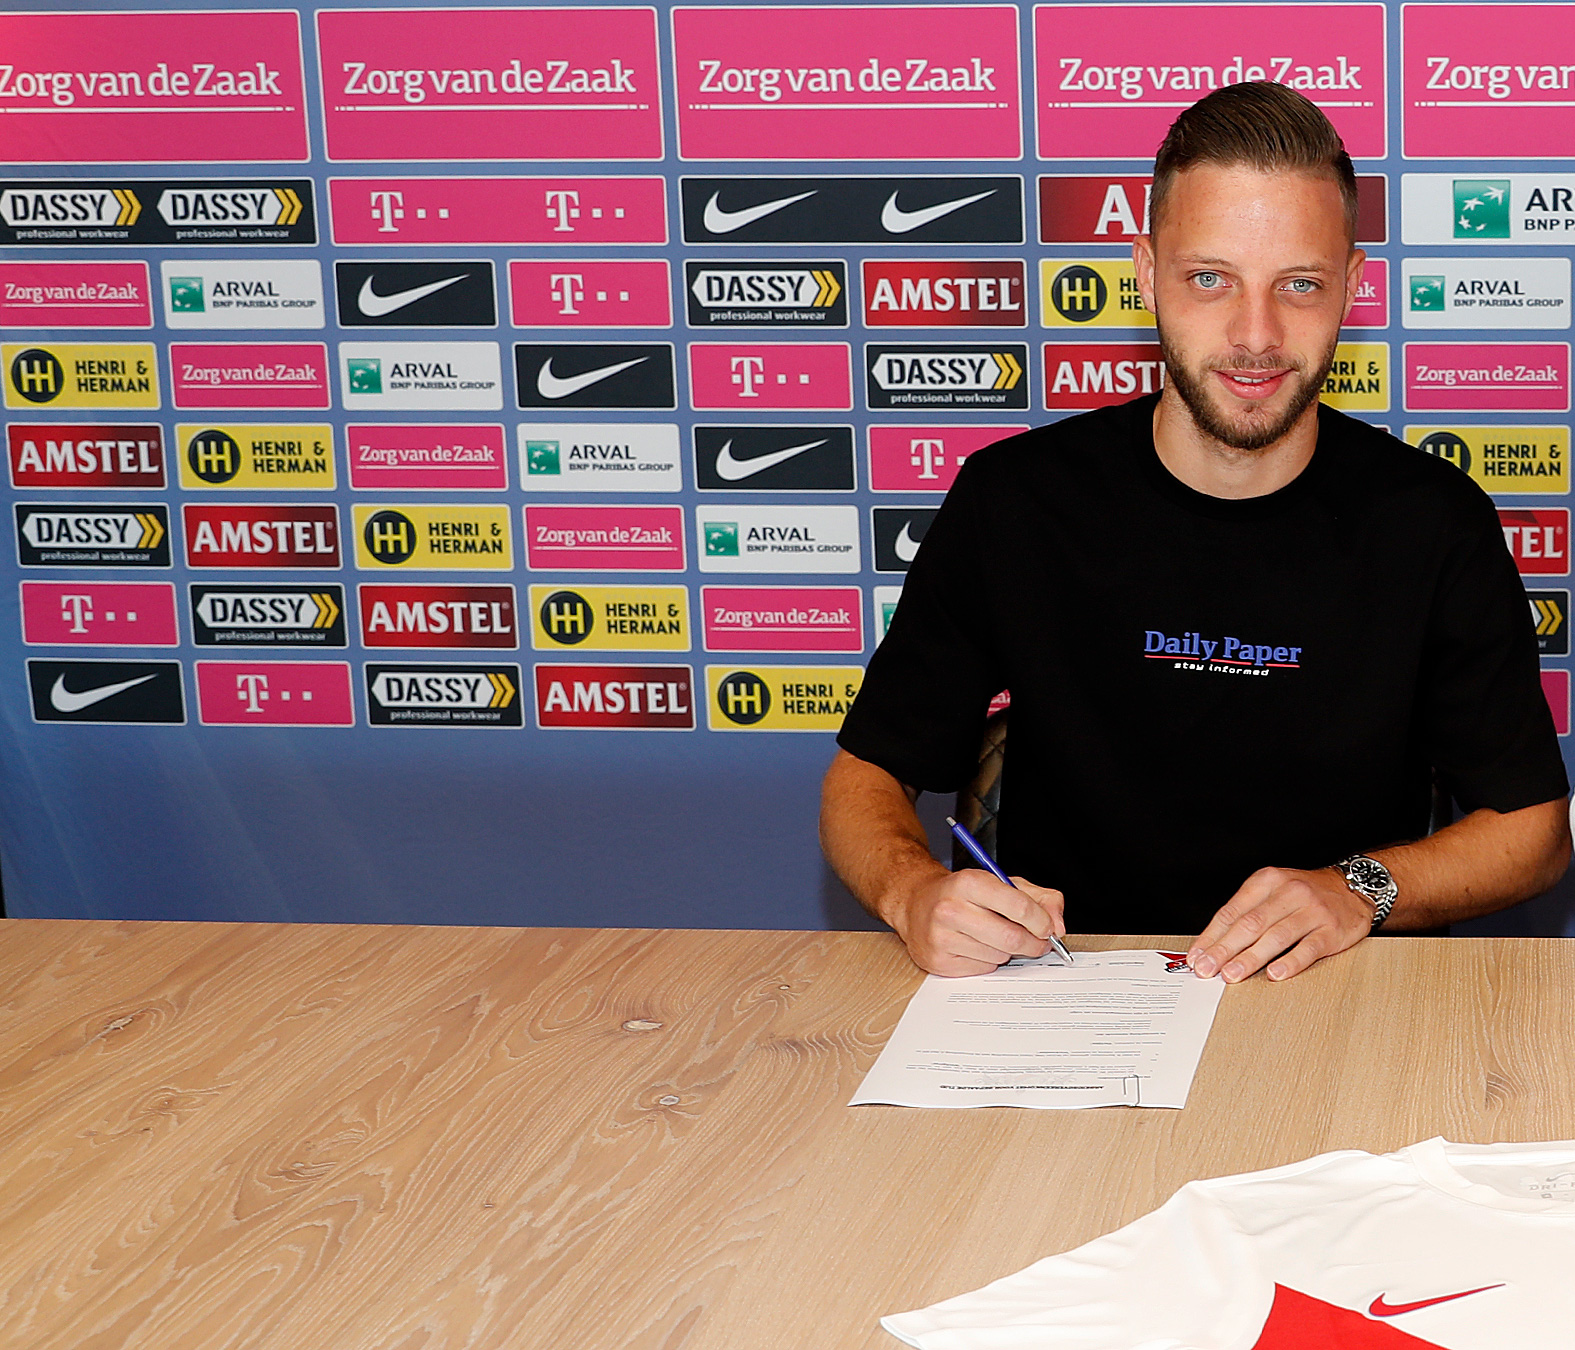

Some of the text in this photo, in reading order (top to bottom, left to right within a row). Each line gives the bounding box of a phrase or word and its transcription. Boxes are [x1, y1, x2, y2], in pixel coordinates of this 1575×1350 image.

[0, 61, 282, 107] Zorg van de Zaak
[343, 59, 637, 103] Zorg van de Zaak
[699, 58, 996, 101] Zorg van de Zaak
[1059, 57, 1144, 100] Zorg
[1147, 65, 1218, 90] van
[1271, 56, 1362, 90] Zaak
[1426, 57, 1511, 99] Zorg
[11, 194, 106, 221] DASSY
[171, 193, 268, 220] DASSY
[1524, 219, 1560, 230] BNP
[4, 282, 139, 304] Zorg van de Zaak
[213, 281, 279, 297] ARVAL
[706, 276, 805, 302] DASSY
[870, 278, 1020, 311] AMSTEL
[1455, 281, 1525, 295] ARVAL
[75, 360, 148, 375] HENRI &
[390, 363, 458, 378] ARVAL
[887, 358, 987, 385] DASSY
[1051, 361, 1164, 394] AMST
[1416, 365, 1558, 385] Zorg van de Zaak
[77, 377, 150, 392] HERMAN
[18, 440, 159, 473] AMSTEL
[251, 441, 325, 456] HENRI &
[569, 445, 636, 460] ARVAL
[1484, 444, 1561, 459] HENRI &
[253, 458, 326, 473] HERMAN
[1484, 461, 1561, 476] HERMAN
[36, 517, 129, 543] DASSY
[193, 521, 334, 553] AMSTEL
[747, 527, 815, 541] ARVAL
[210, 598, 305, 623] DASSY
[369, 601, 511, 633] AMSTEL
[606, 603, 679, 618] HENRI &
[714, 608, 851, 629] Zorg van de Zaak
[607, 619, 680, 634] HERMAN
[1144, 630, 1302, 666] Daily Paper
[1173, 661, 1270, 676] stay informed
[385, 677, 481, 702] DASSY
[544, 681, 687, 713] AMSTEL
